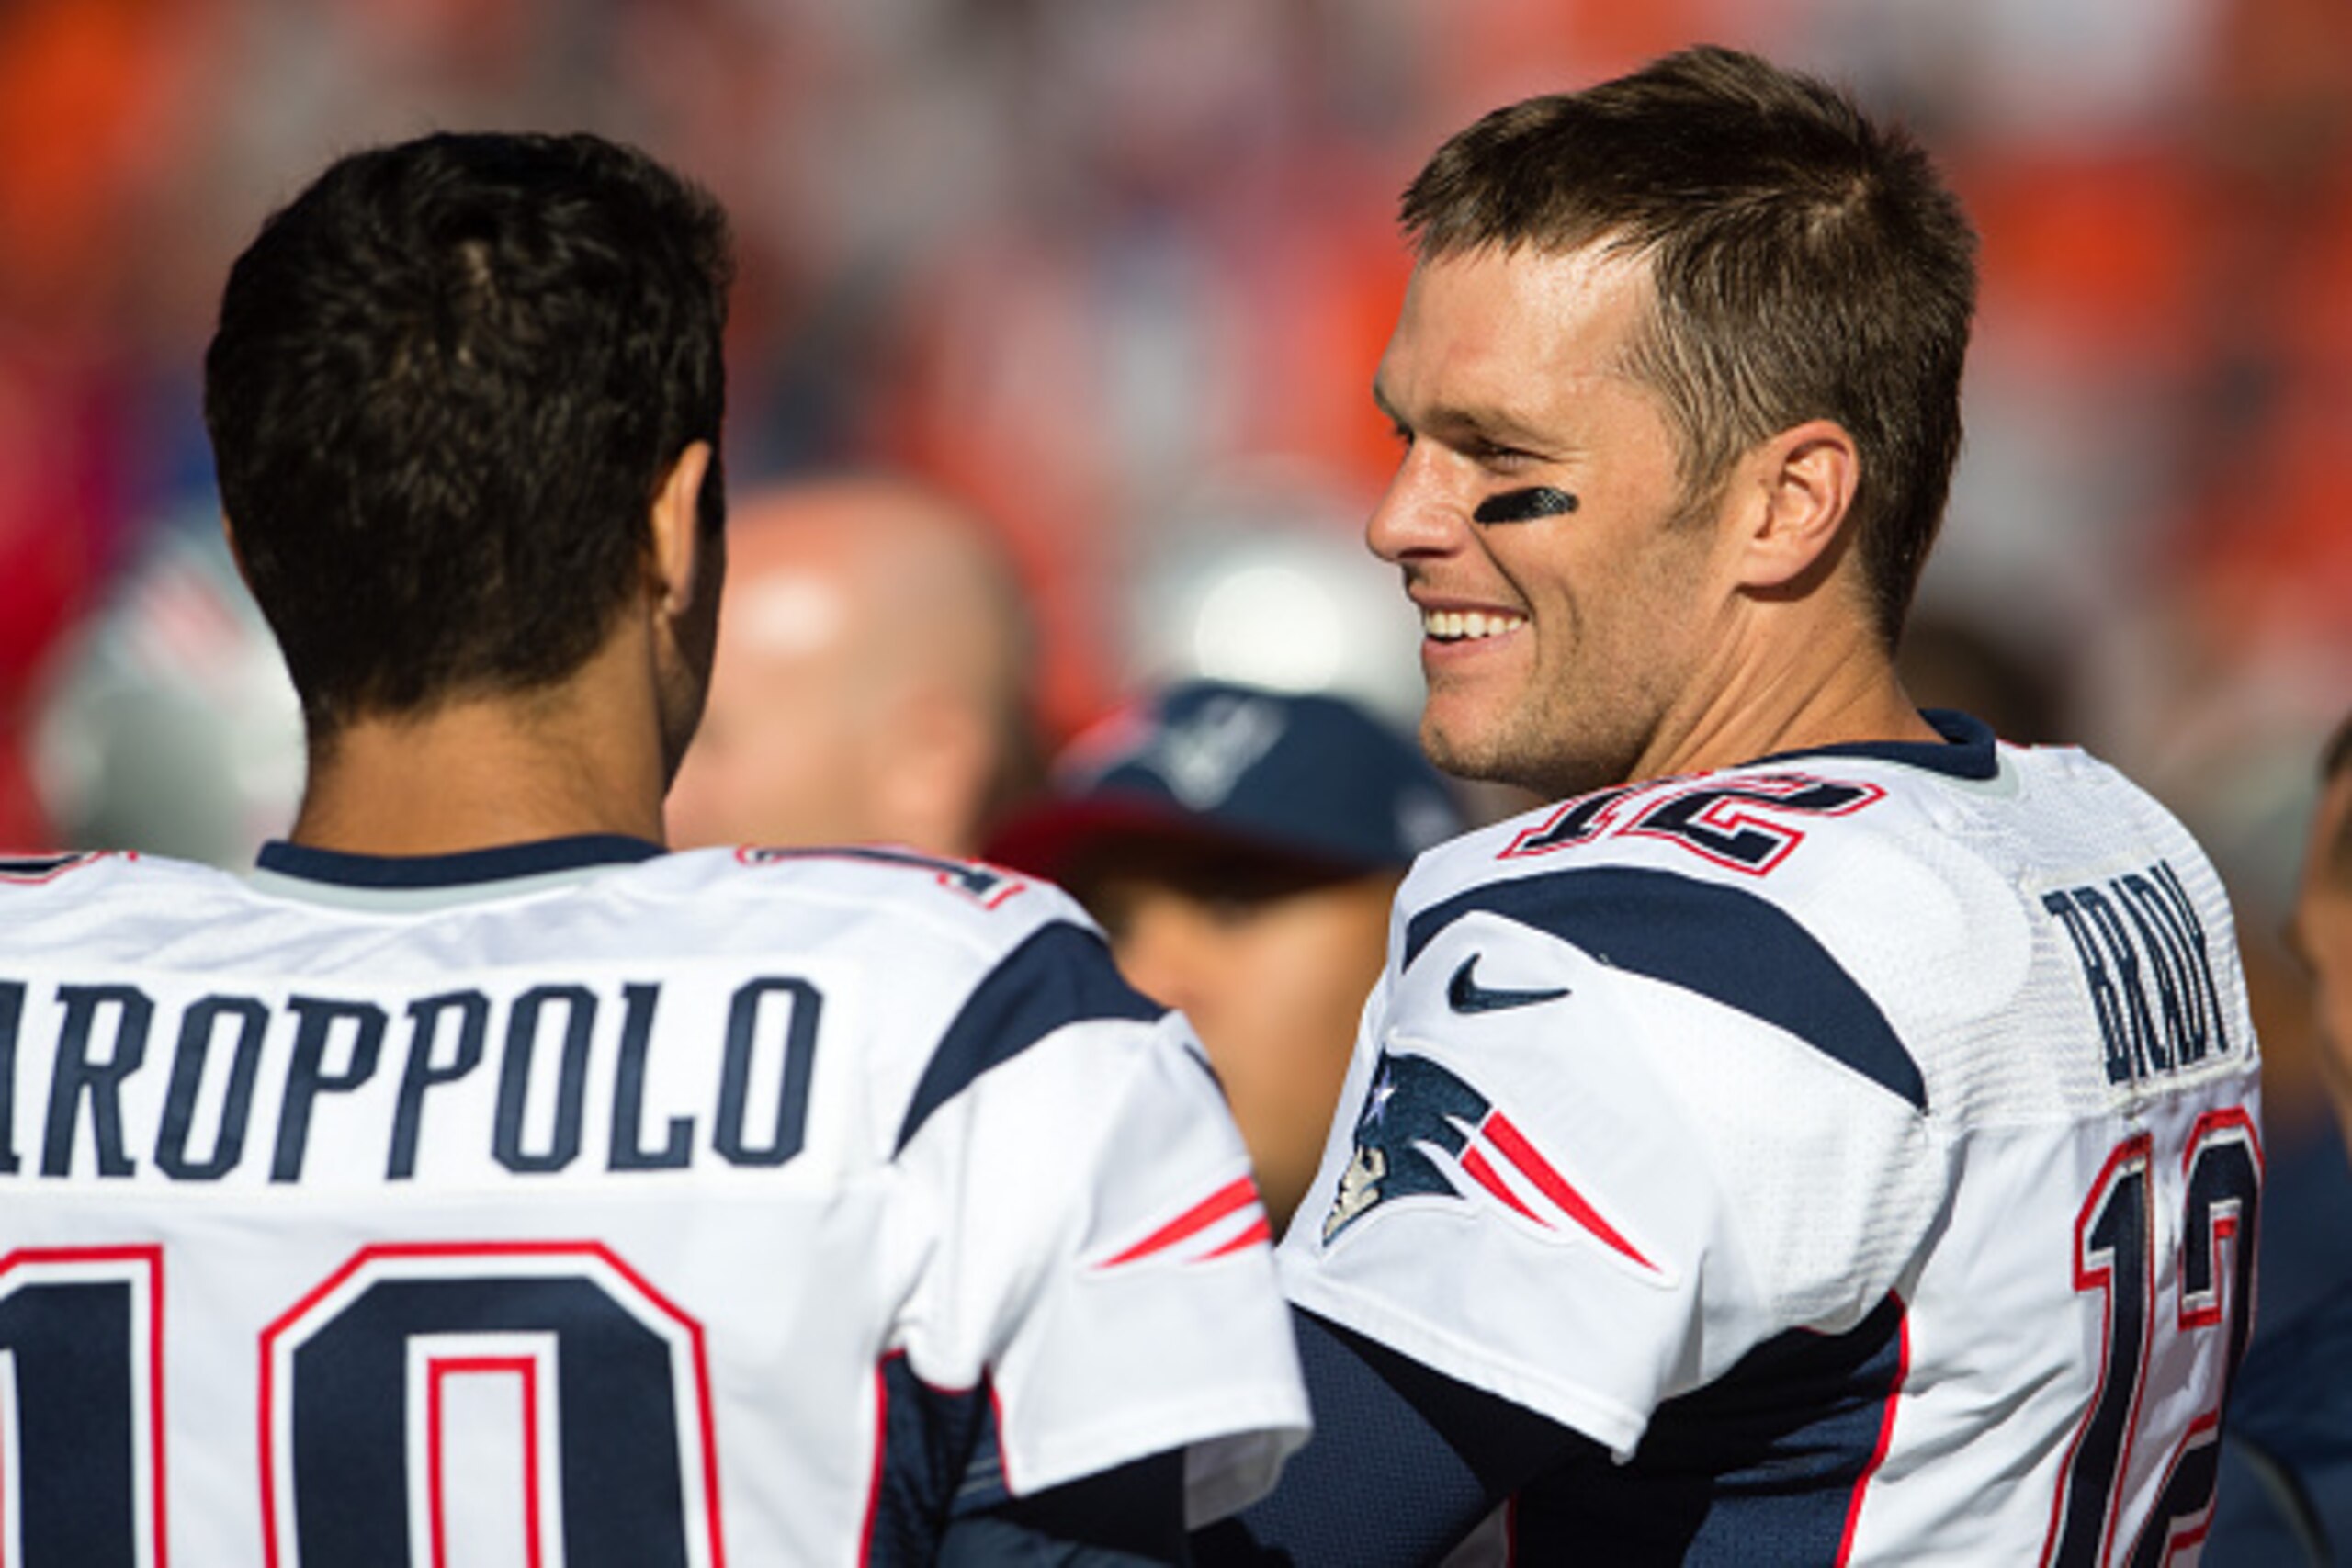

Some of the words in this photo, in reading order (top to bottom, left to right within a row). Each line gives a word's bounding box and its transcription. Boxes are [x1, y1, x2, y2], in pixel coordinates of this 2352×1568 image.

[1497, 770, 1887, 877] 12
[0, 976, 824, 1183] ROPPOLO
[2041, 859, 2229, 1085] BRADY
[2038, 1106, 2265, 1568] 12
